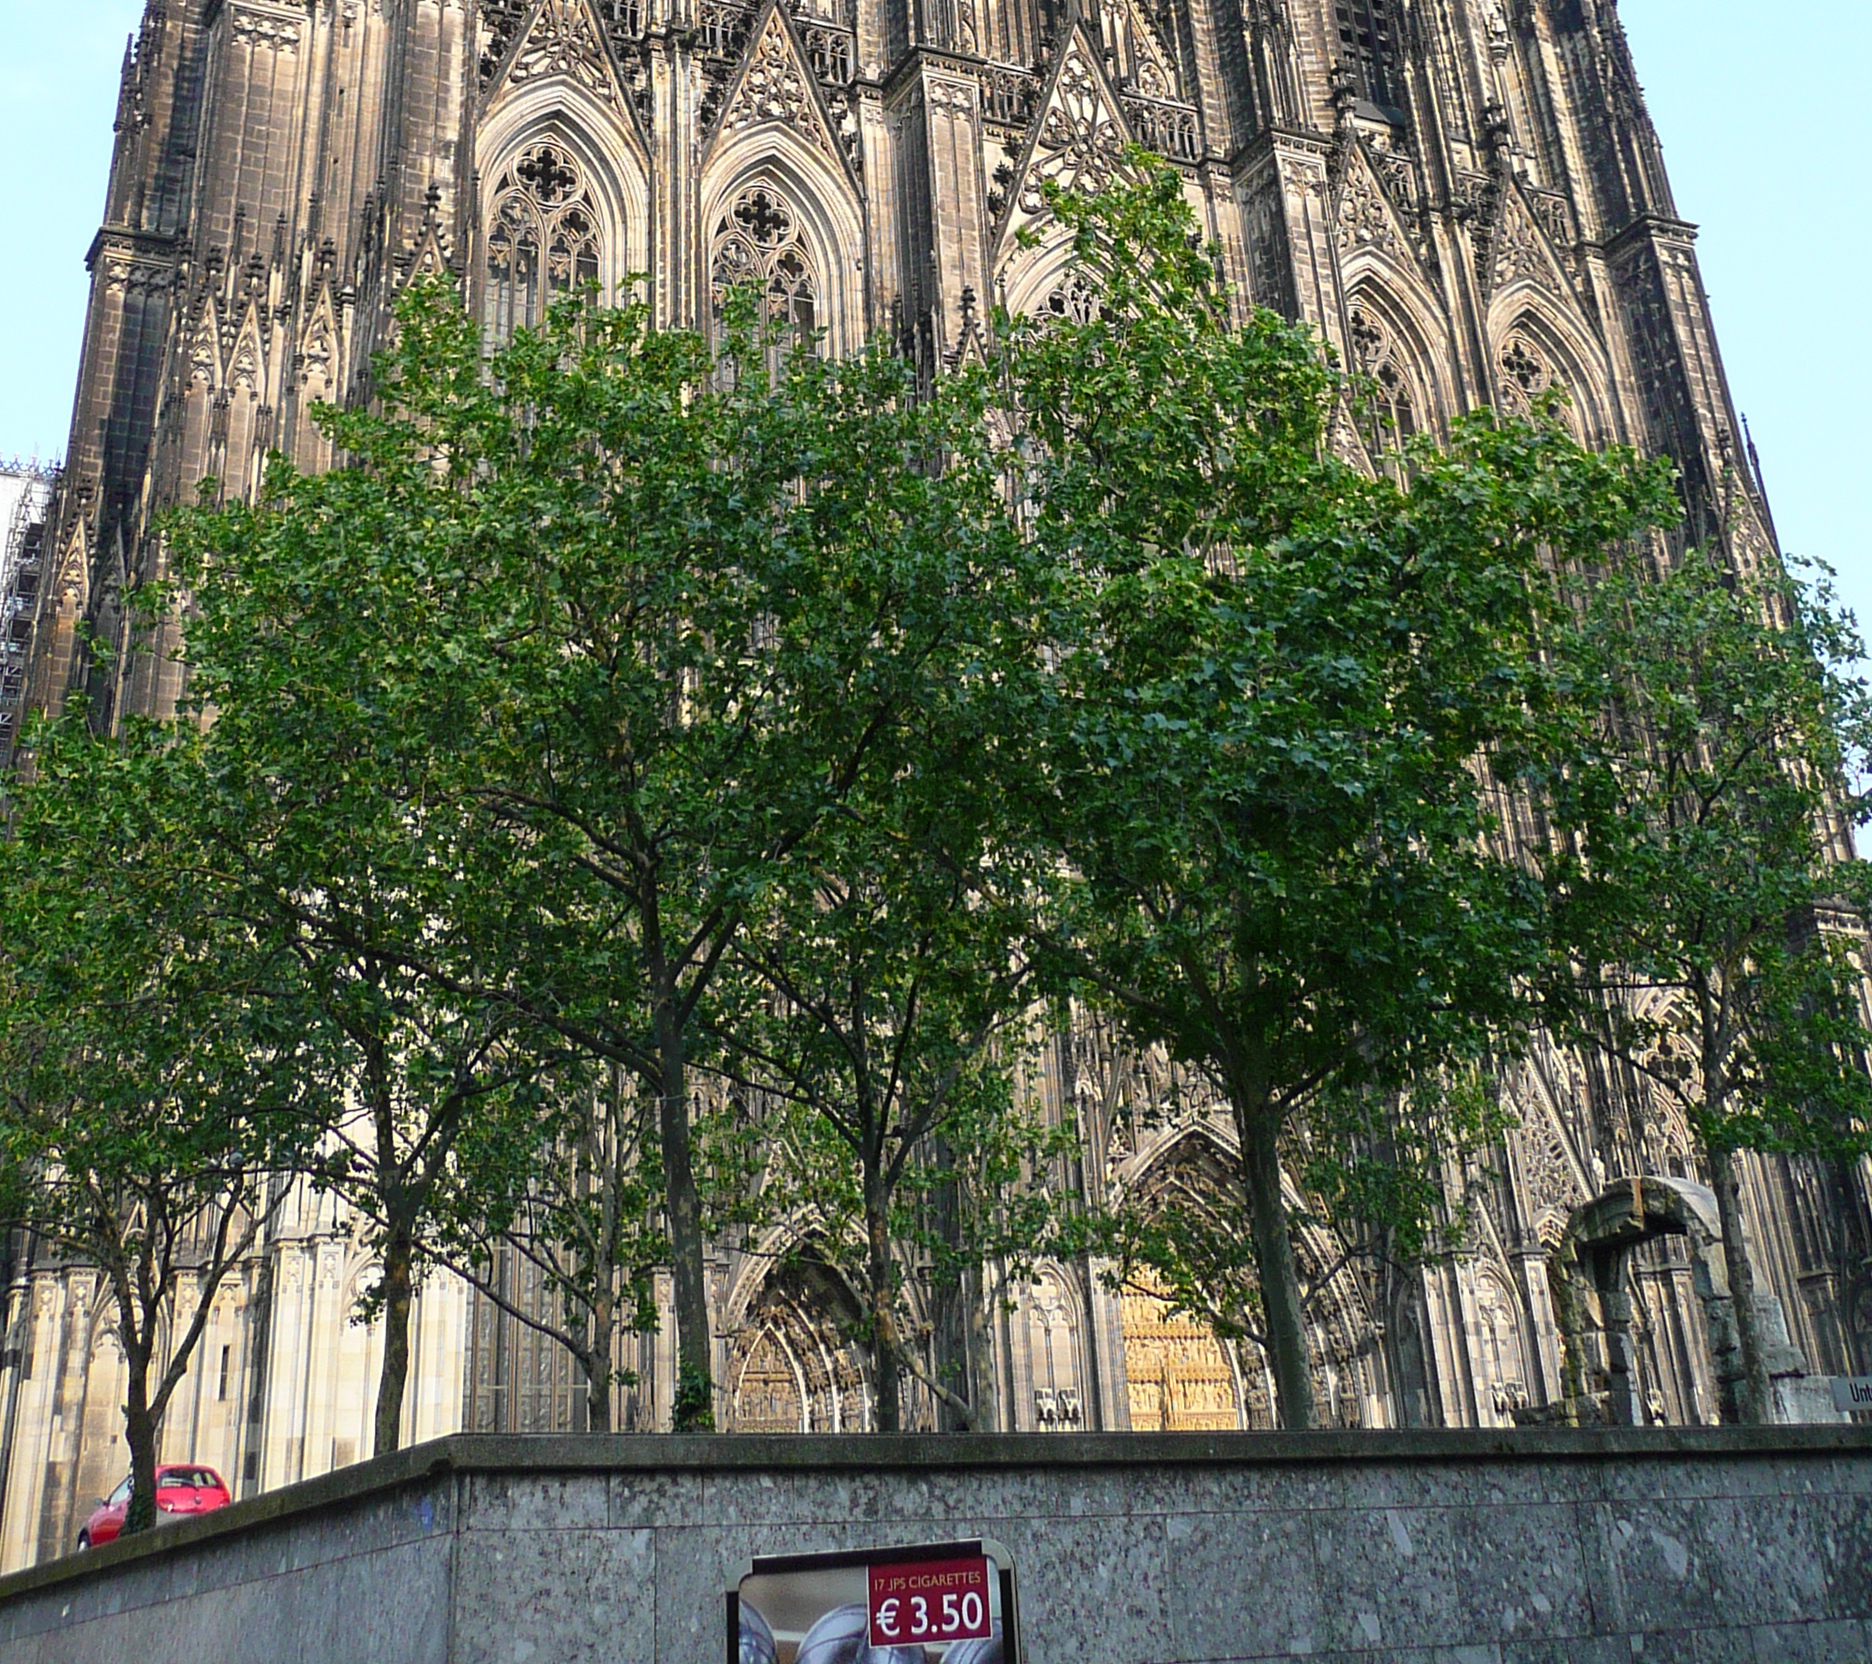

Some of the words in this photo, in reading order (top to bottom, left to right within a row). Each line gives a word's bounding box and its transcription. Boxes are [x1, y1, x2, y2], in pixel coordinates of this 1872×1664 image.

[1849, 1382, 1872, 1403] Unt
[874, 1578, 885, 1592] 17
[888, 1577, 906, 1592] JPS
[908, 1571, 981, 1589] CIGARETTES
